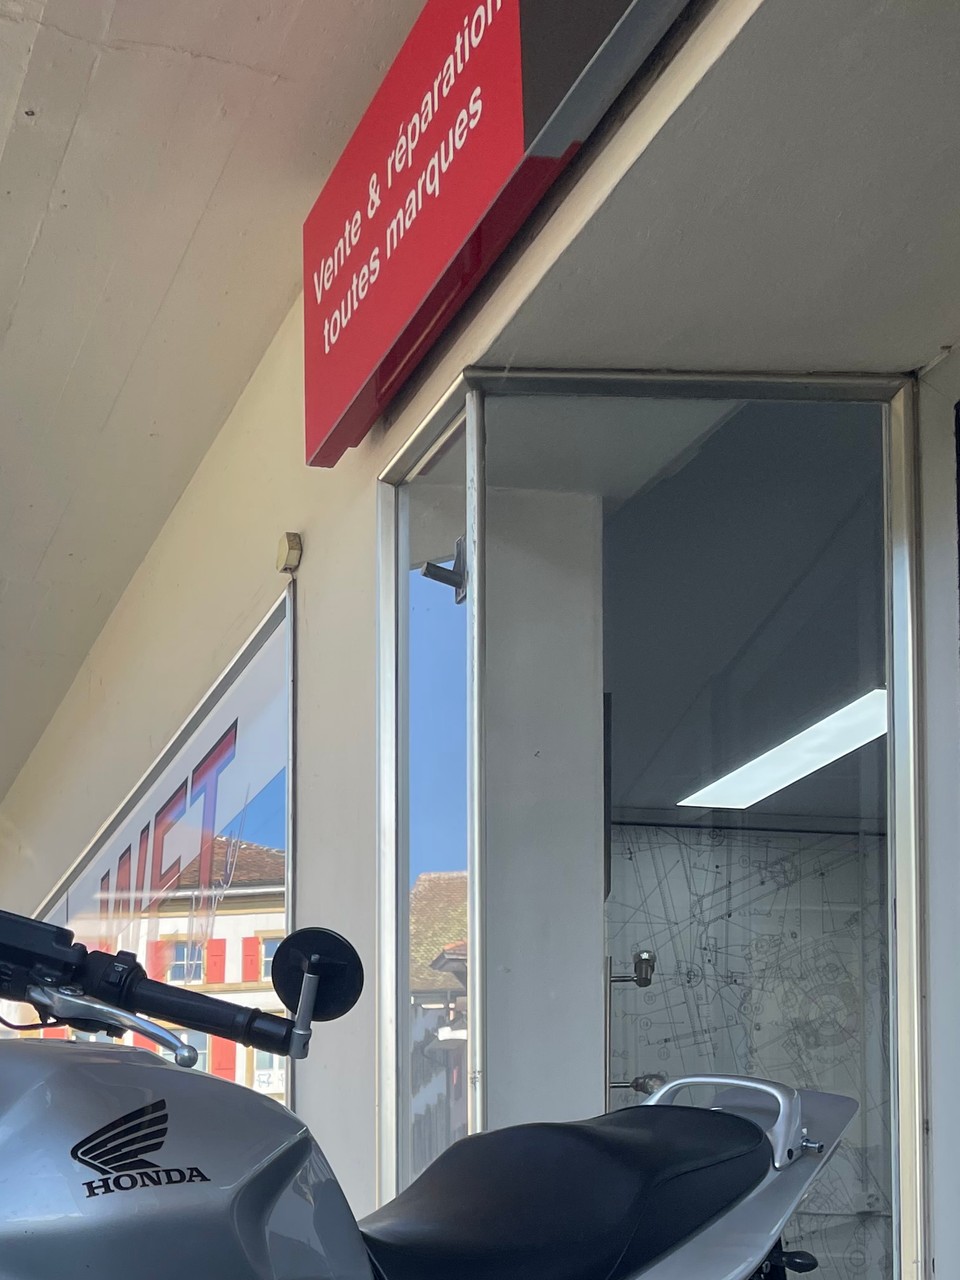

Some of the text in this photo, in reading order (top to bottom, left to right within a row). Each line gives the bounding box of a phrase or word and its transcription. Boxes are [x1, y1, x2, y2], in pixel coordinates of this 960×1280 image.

[313, 210, 362, 305] Vente
[367, 172, 381, 219] &
[323, 86, 483, 355] toutes marques
[82, 1167, 211, 1198] HONDA
